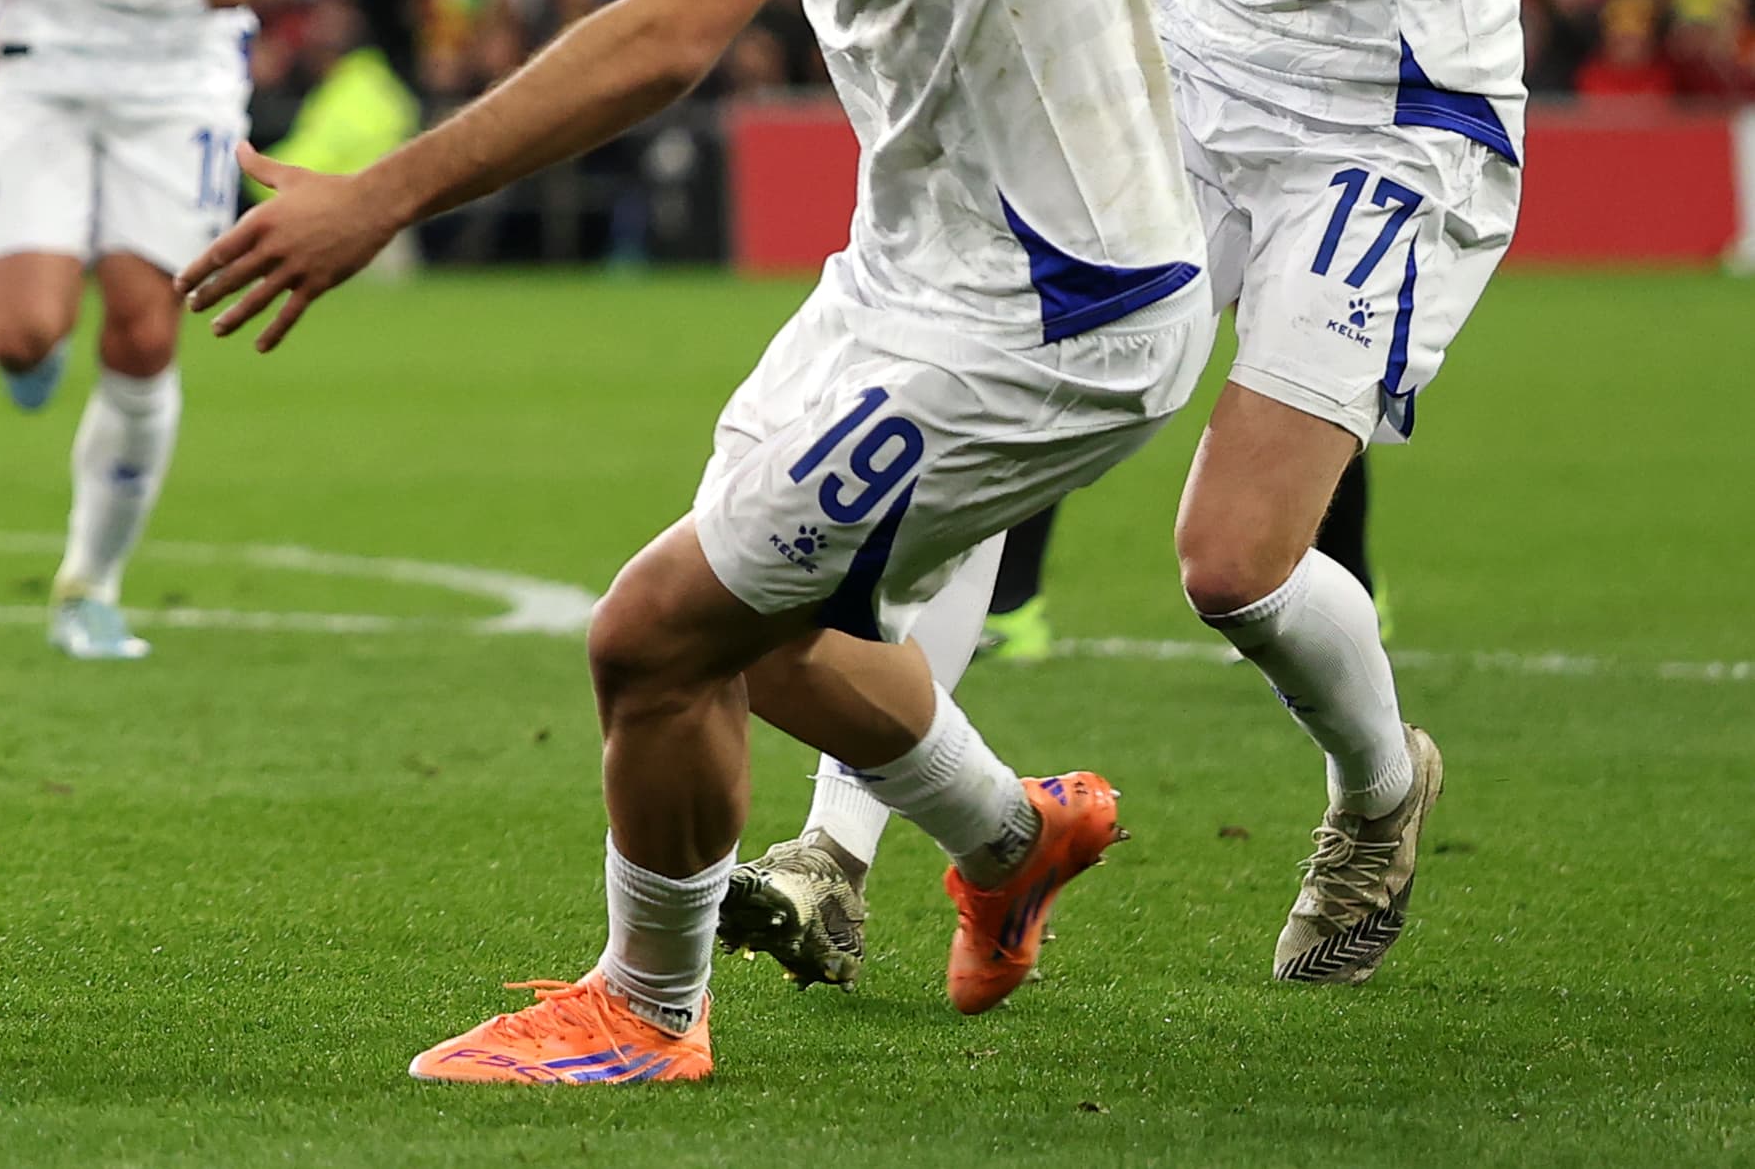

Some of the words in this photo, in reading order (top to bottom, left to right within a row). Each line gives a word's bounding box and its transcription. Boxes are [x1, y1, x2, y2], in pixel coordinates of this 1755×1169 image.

[1310, 167, 1424, 289] 17
[1327, 319, 1373, 348] KELME
[788, 387, 925, 524] 19
[769, 534, 819, 574] KELME
